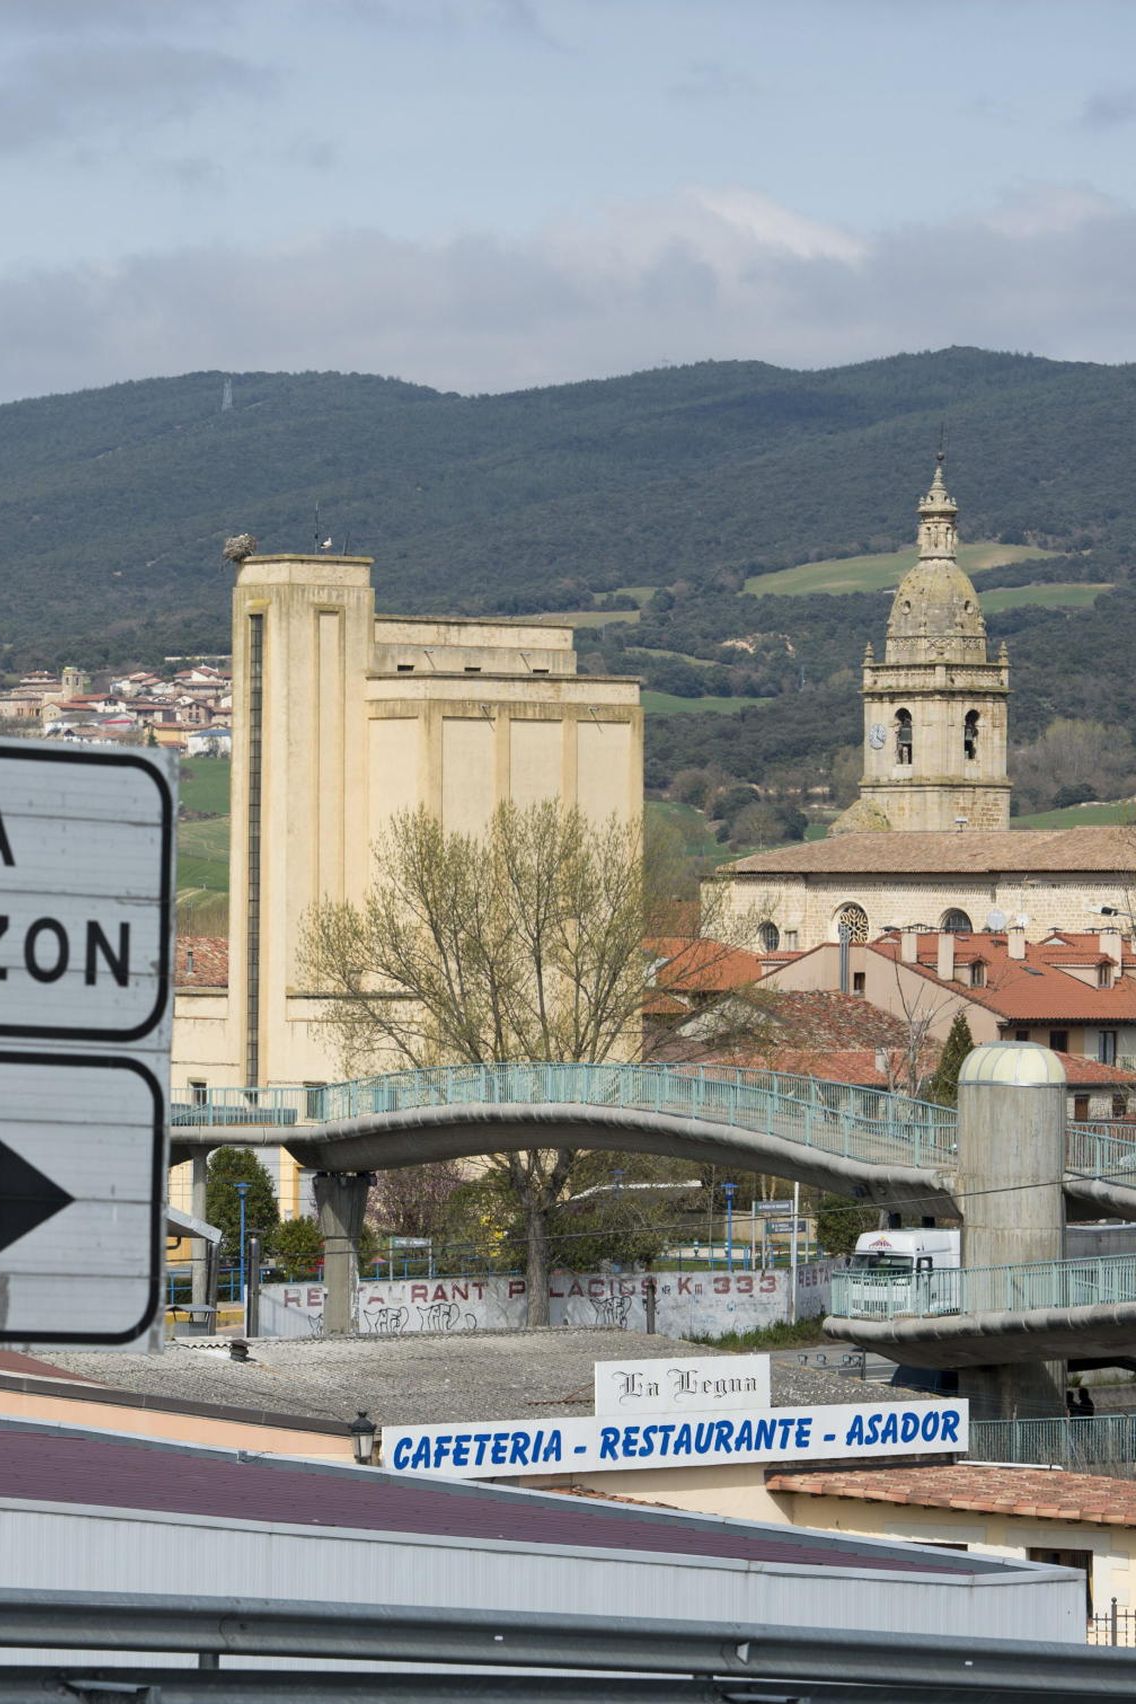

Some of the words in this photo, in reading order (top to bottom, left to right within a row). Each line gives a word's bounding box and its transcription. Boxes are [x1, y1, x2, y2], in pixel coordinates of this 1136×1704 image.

[508, 1276, 658, 1299] PLACIOS
[713, 1275, 777, 1295] 333
[612, 1370, 660, 1406] La
[392, 1429, 563, 1471] CAFETERIA
[598, 1417, 813, 1461] RESTAURANTE
[845, 1408, 960, 1447] ASADOR
